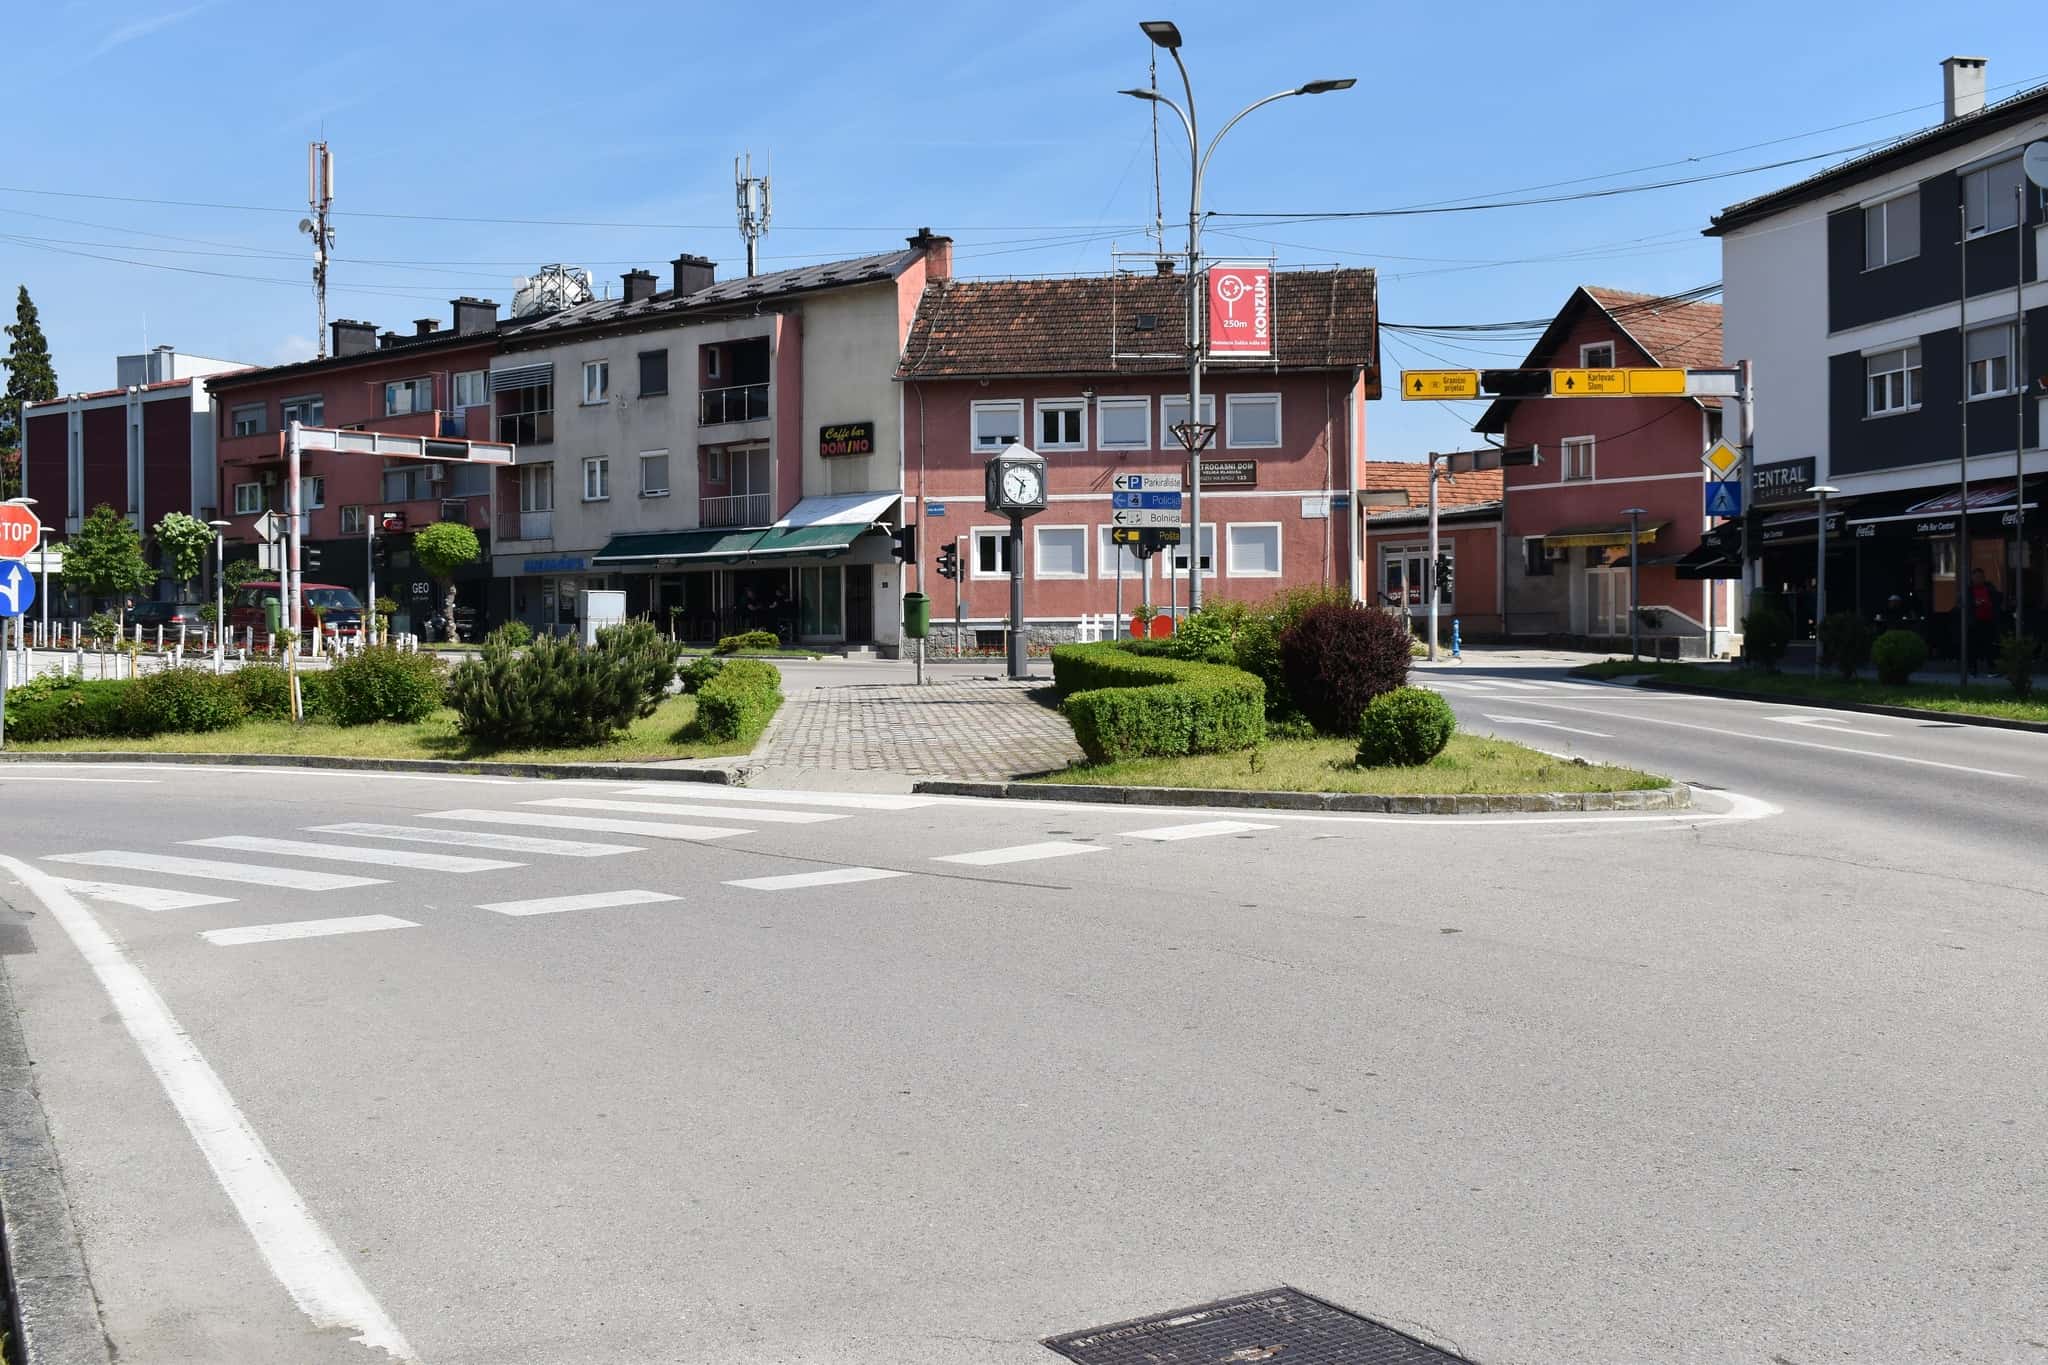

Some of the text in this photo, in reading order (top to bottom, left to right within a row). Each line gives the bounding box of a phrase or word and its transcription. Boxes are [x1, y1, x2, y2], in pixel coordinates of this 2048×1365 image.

[1254, 275, 1267, 338] KONZUM
[1223, 319, 1248, 328] 250m
[821, 439, 869, 456] DOMINO
[1200, 462, 1254, 471] TROGASNI DOM
[1152, 495, 1181, 507] Policija
[1150, 513, 1180, 523] Bolnica
[0, 521, 33, 542] TOP
[412, 582, 430, 593] GEO
